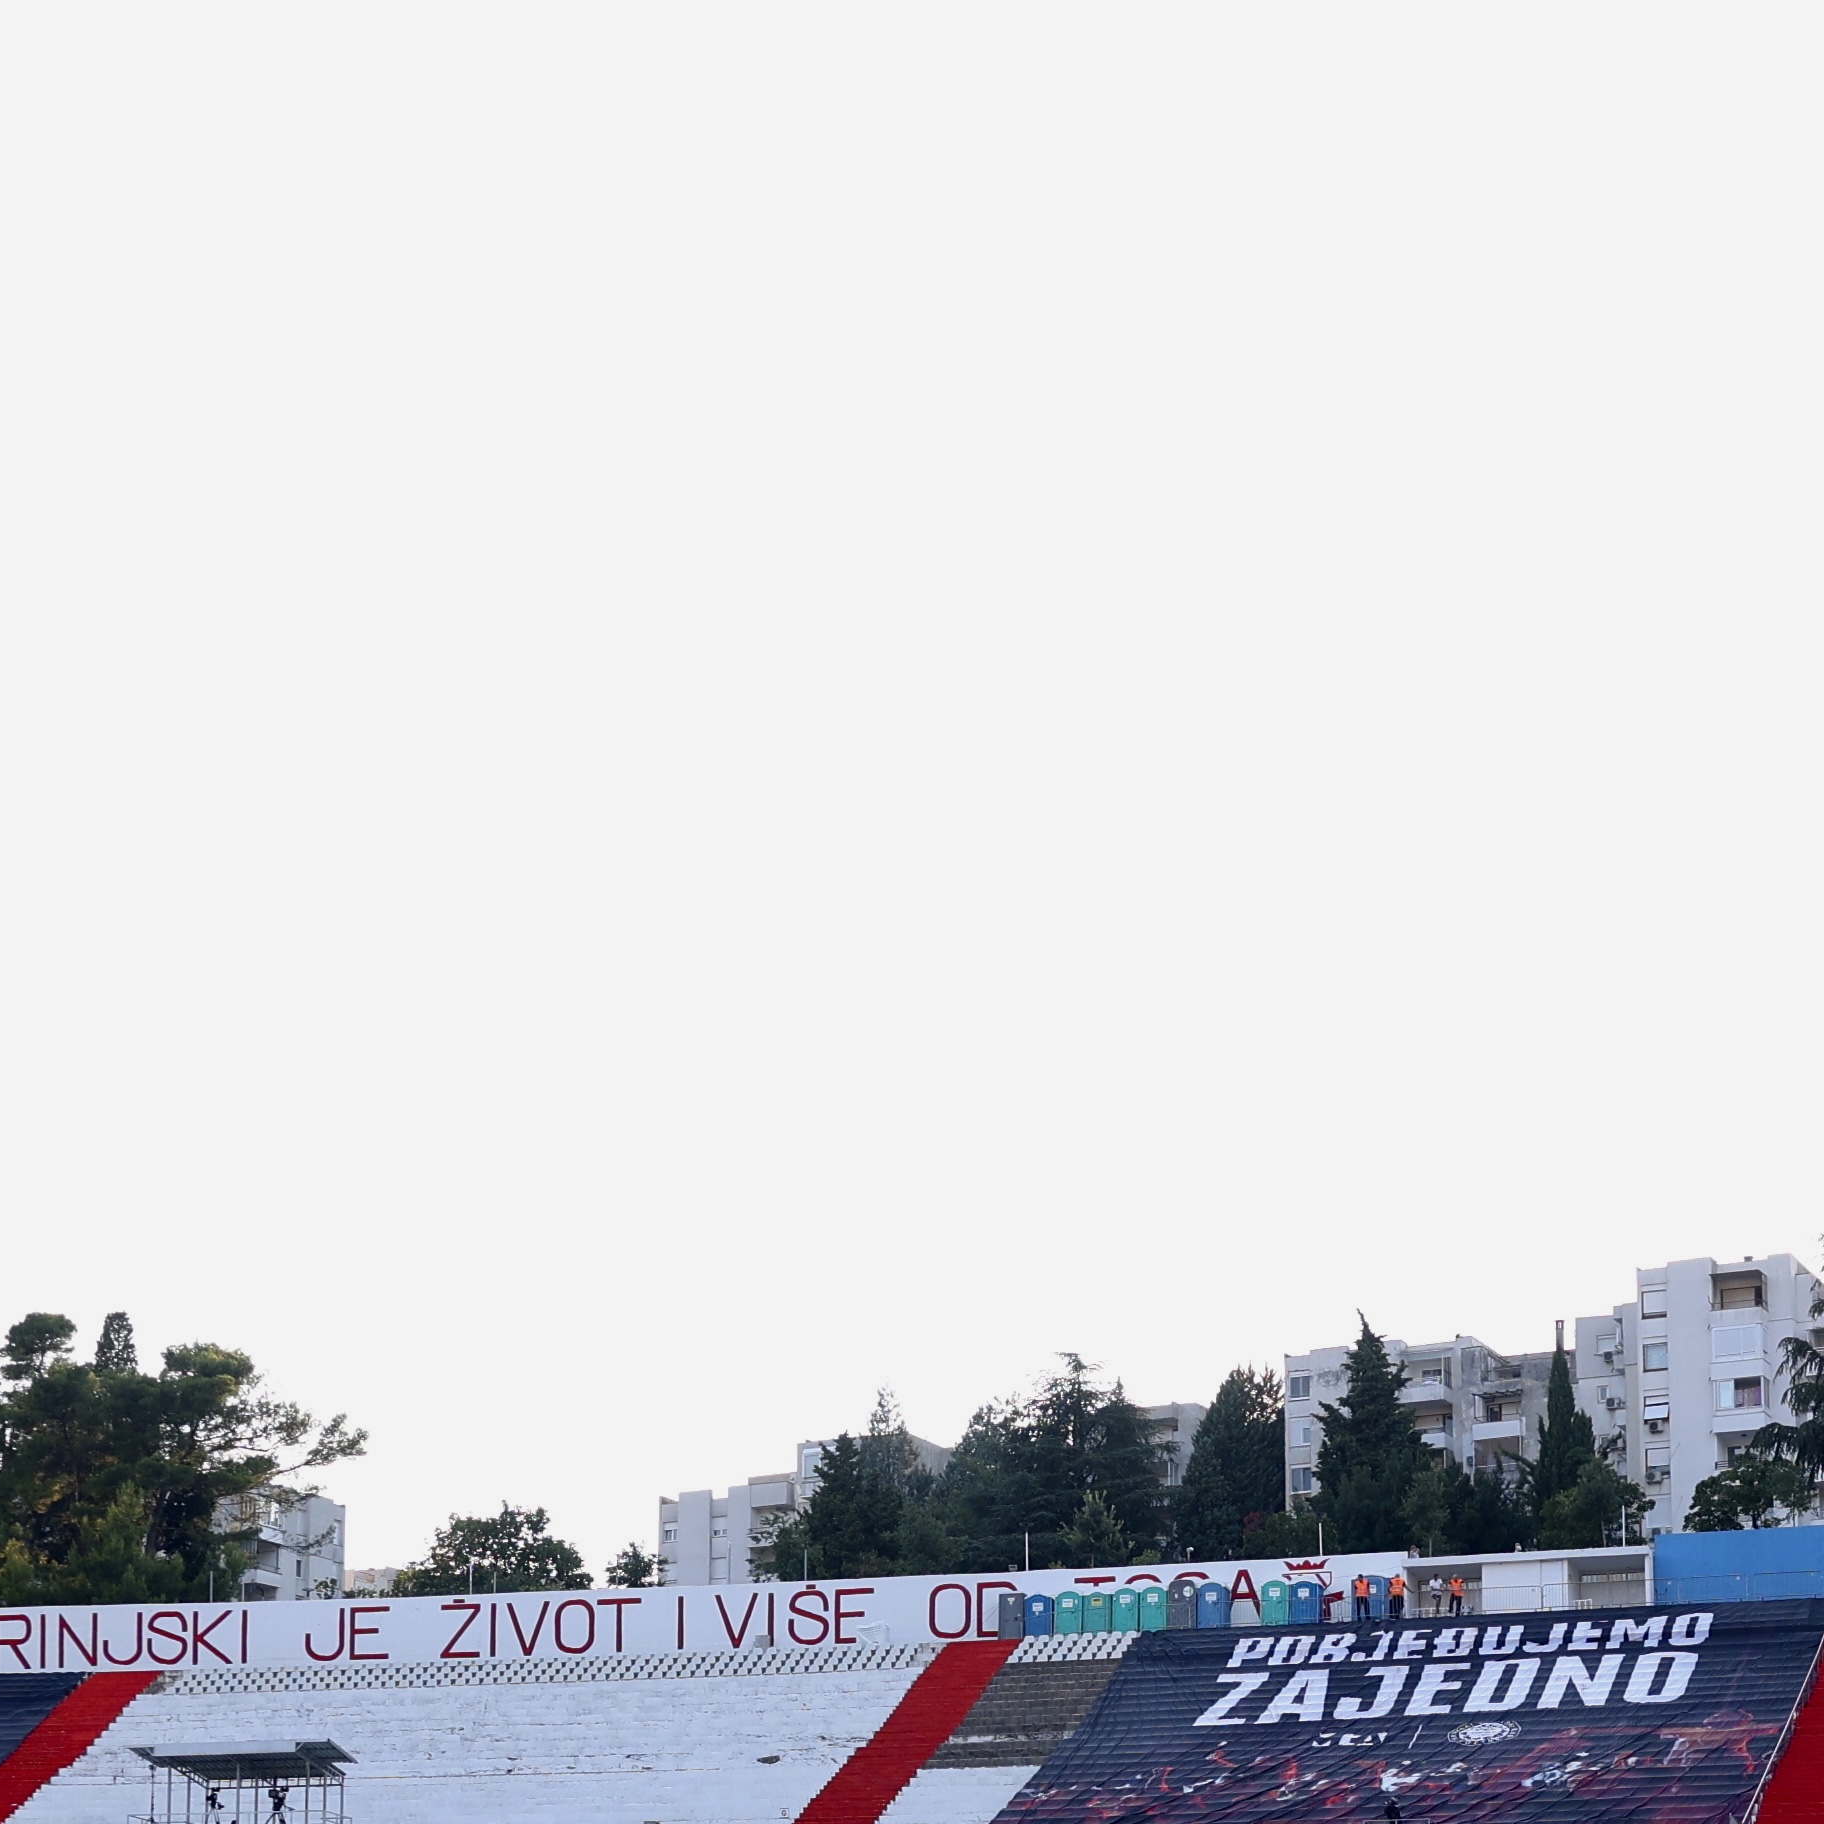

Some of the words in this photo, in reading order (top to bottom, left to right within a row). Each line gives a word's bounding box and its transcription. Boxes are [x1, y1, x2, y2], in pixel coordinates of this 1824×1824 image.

[305, 1606, 391, 1662] JE
[678, 1597, 684, 1650] I
[929, 1581, 1018, 1639] OD
[1192, 1651, 1700, 1727] ZAJEDNO
